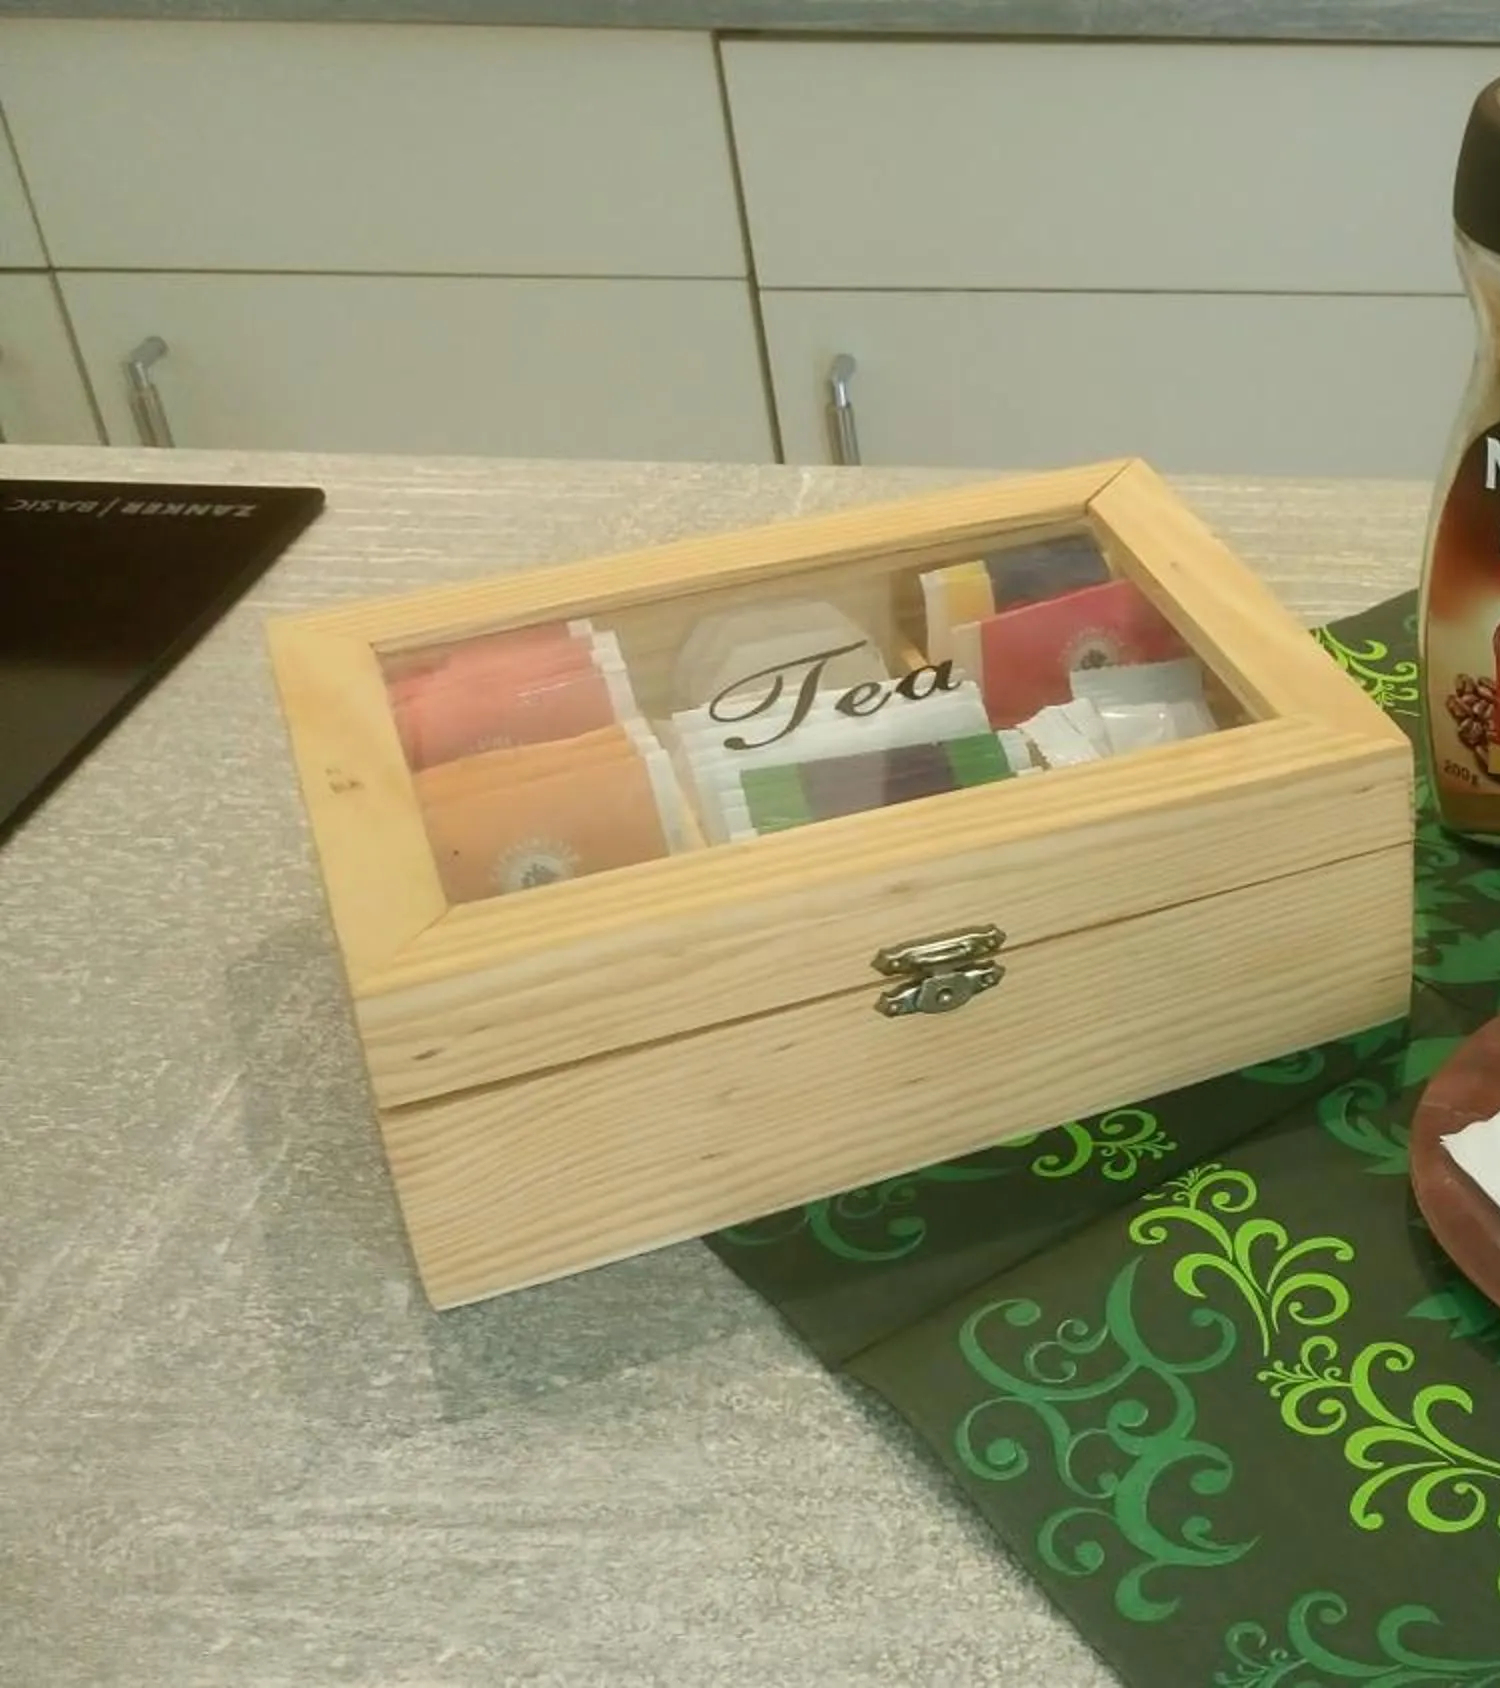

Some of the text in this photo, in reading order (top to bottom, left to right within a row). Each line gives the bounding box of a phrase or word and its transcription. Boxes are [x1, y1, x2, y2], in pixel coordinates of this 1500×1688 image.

[5, 499, 99, 513] BASIC
[121, 502, 257, 518] ZANKER
[708, 640, 964, 751] Tea
